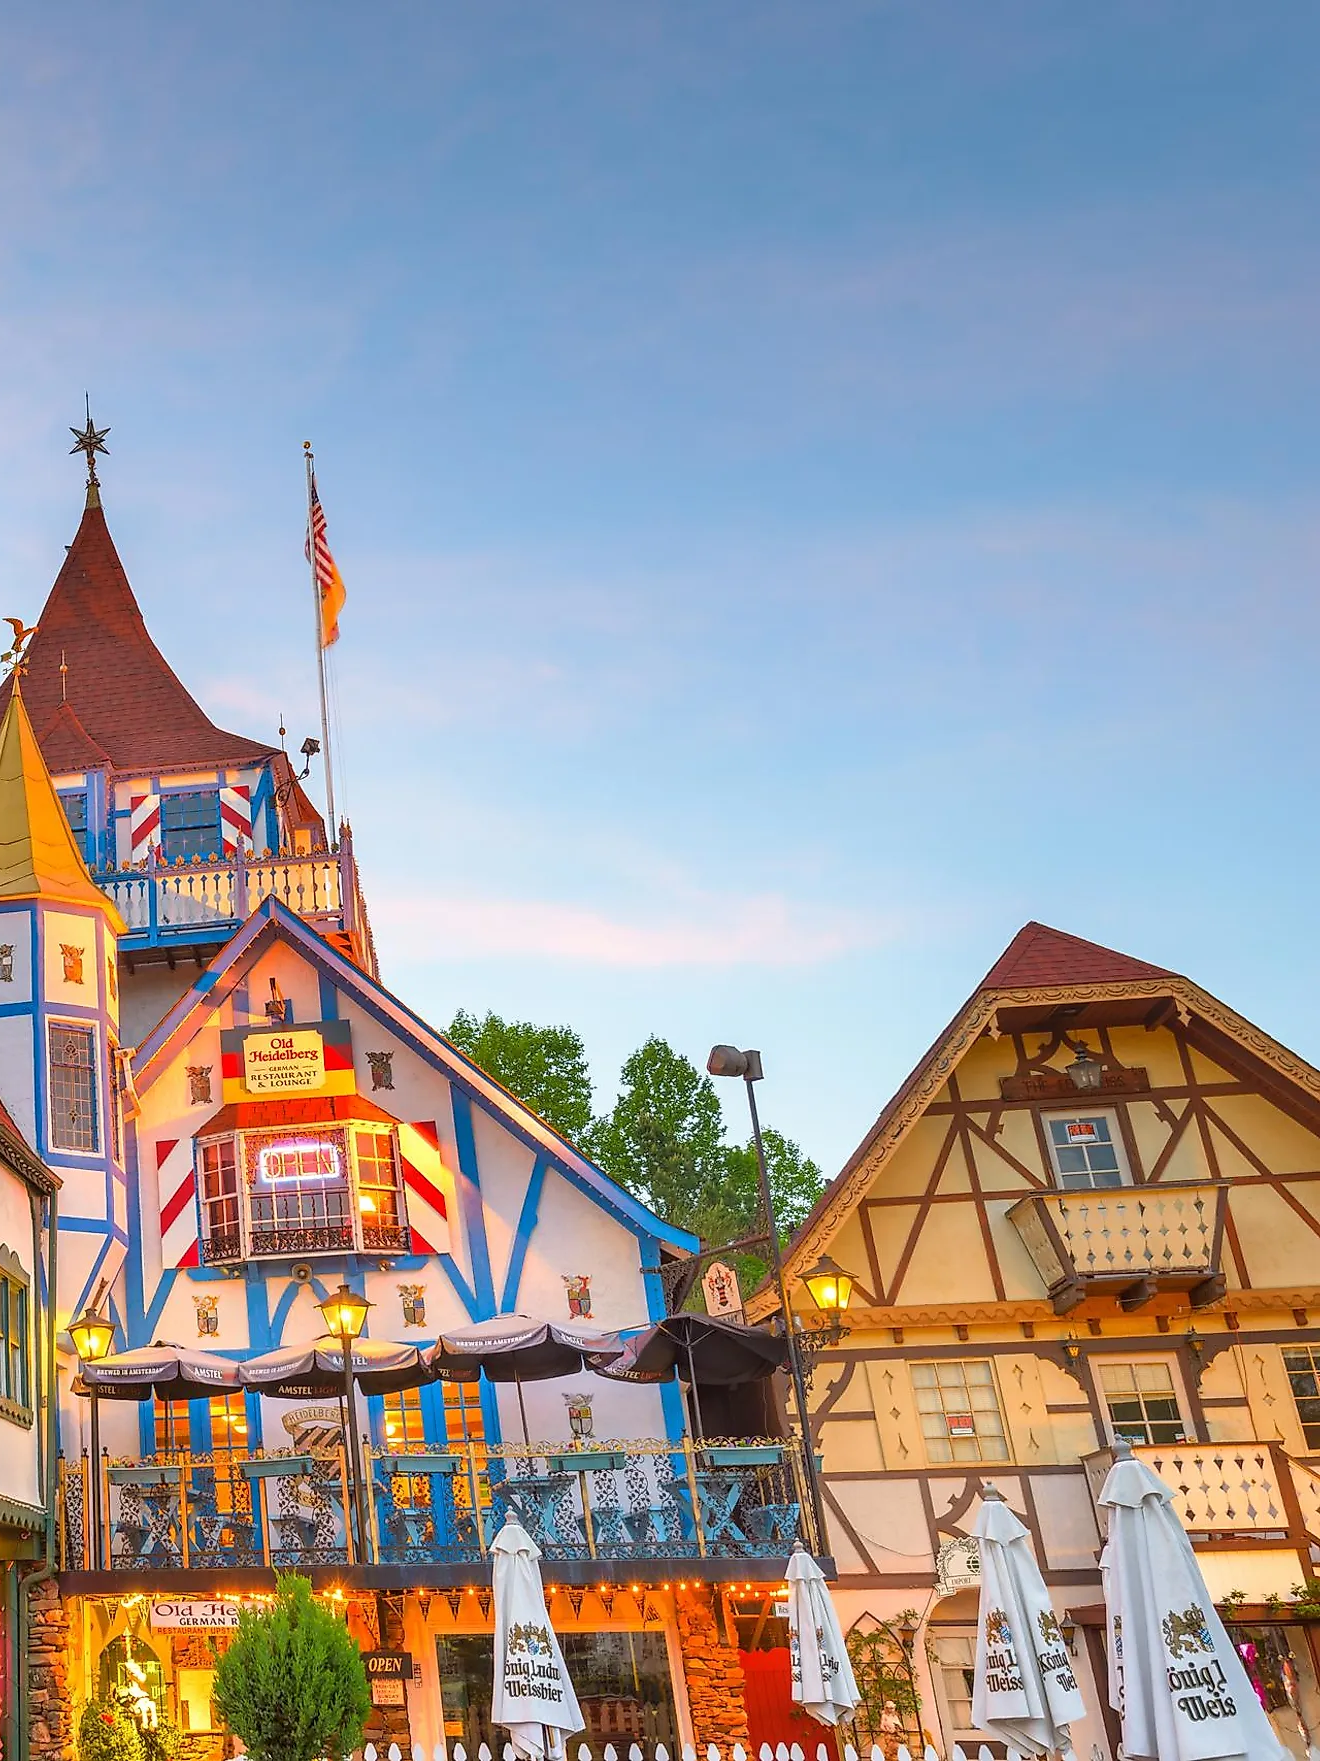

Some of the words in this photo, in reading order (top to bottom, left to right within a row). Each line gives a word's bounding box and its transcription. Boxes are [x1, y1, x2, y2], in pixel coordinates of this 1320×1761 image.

[271, 1037, 293, 1049] Old
[249, 1049, 318, 1063] Heidelberg
[251, 1071, 317, 1081] RESTAURANT
[258, 1080, 266, 1088] &
[271, 1078, 312, 1088] LOUNGE
[262, 1147, 335, 1178] OPEN
[195, 1367, 222, 1379] AMSTEL
[278, 1385, 312, 1395] AMSTEL
[155, 1603, 194, 1617] Old
[179, 1617, 226, 1626] GERMAN
[158, 1626, 207, 1635] RESTAURANT
[368, 1657, 403, 1672] OPEN
[504, 1658, 530, 1680] önig
[1166, 1662, 1216, 1693] önig
[504, 1680, 563, 1703] Weissbier
[1177, 1692, 1237, 1722] Weis
